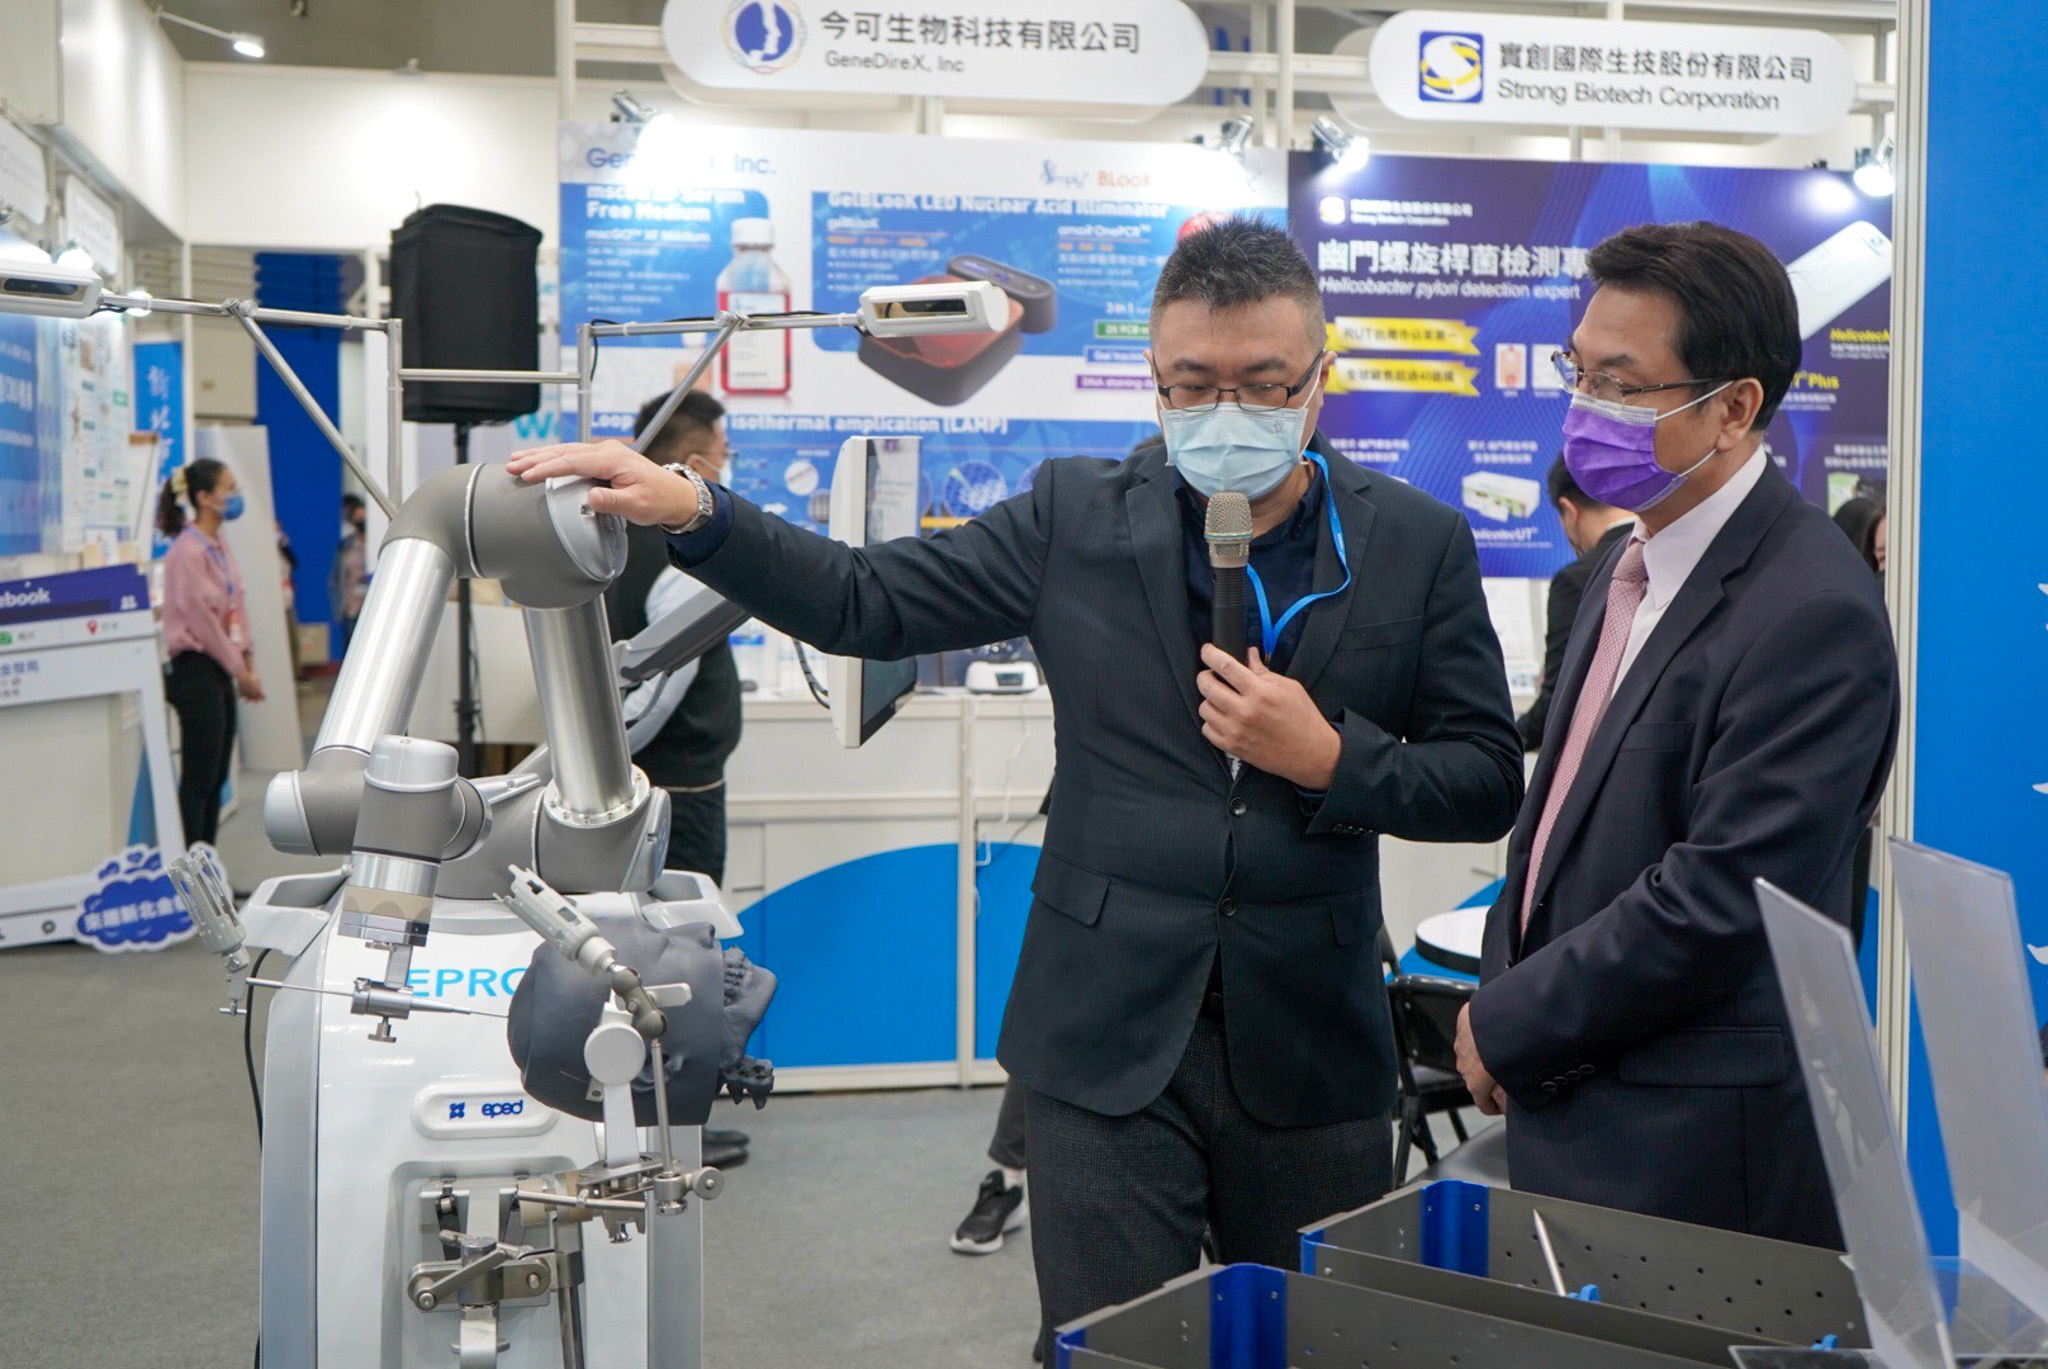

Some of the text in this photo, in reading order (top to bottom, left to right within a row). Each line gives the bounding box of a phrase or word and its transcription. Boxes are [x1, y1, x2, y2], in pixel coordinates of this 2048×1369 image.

[820, 10, 1140, 54] 今可生物科技有限公司
[1499, 42, 1812, 83] 實創國際生技股份有限公司
[1498, 78, 1780, 111] Strong Biotech Corporation
[1317, 238, 1590, 280] 幽門螺旋桿菌檢測專
[1319, 275, 1581, 302] Helicobacter pylori detection expert
[1807, 372, 1840, 390] Plus
[730, 414, 832, 432] isothermal
